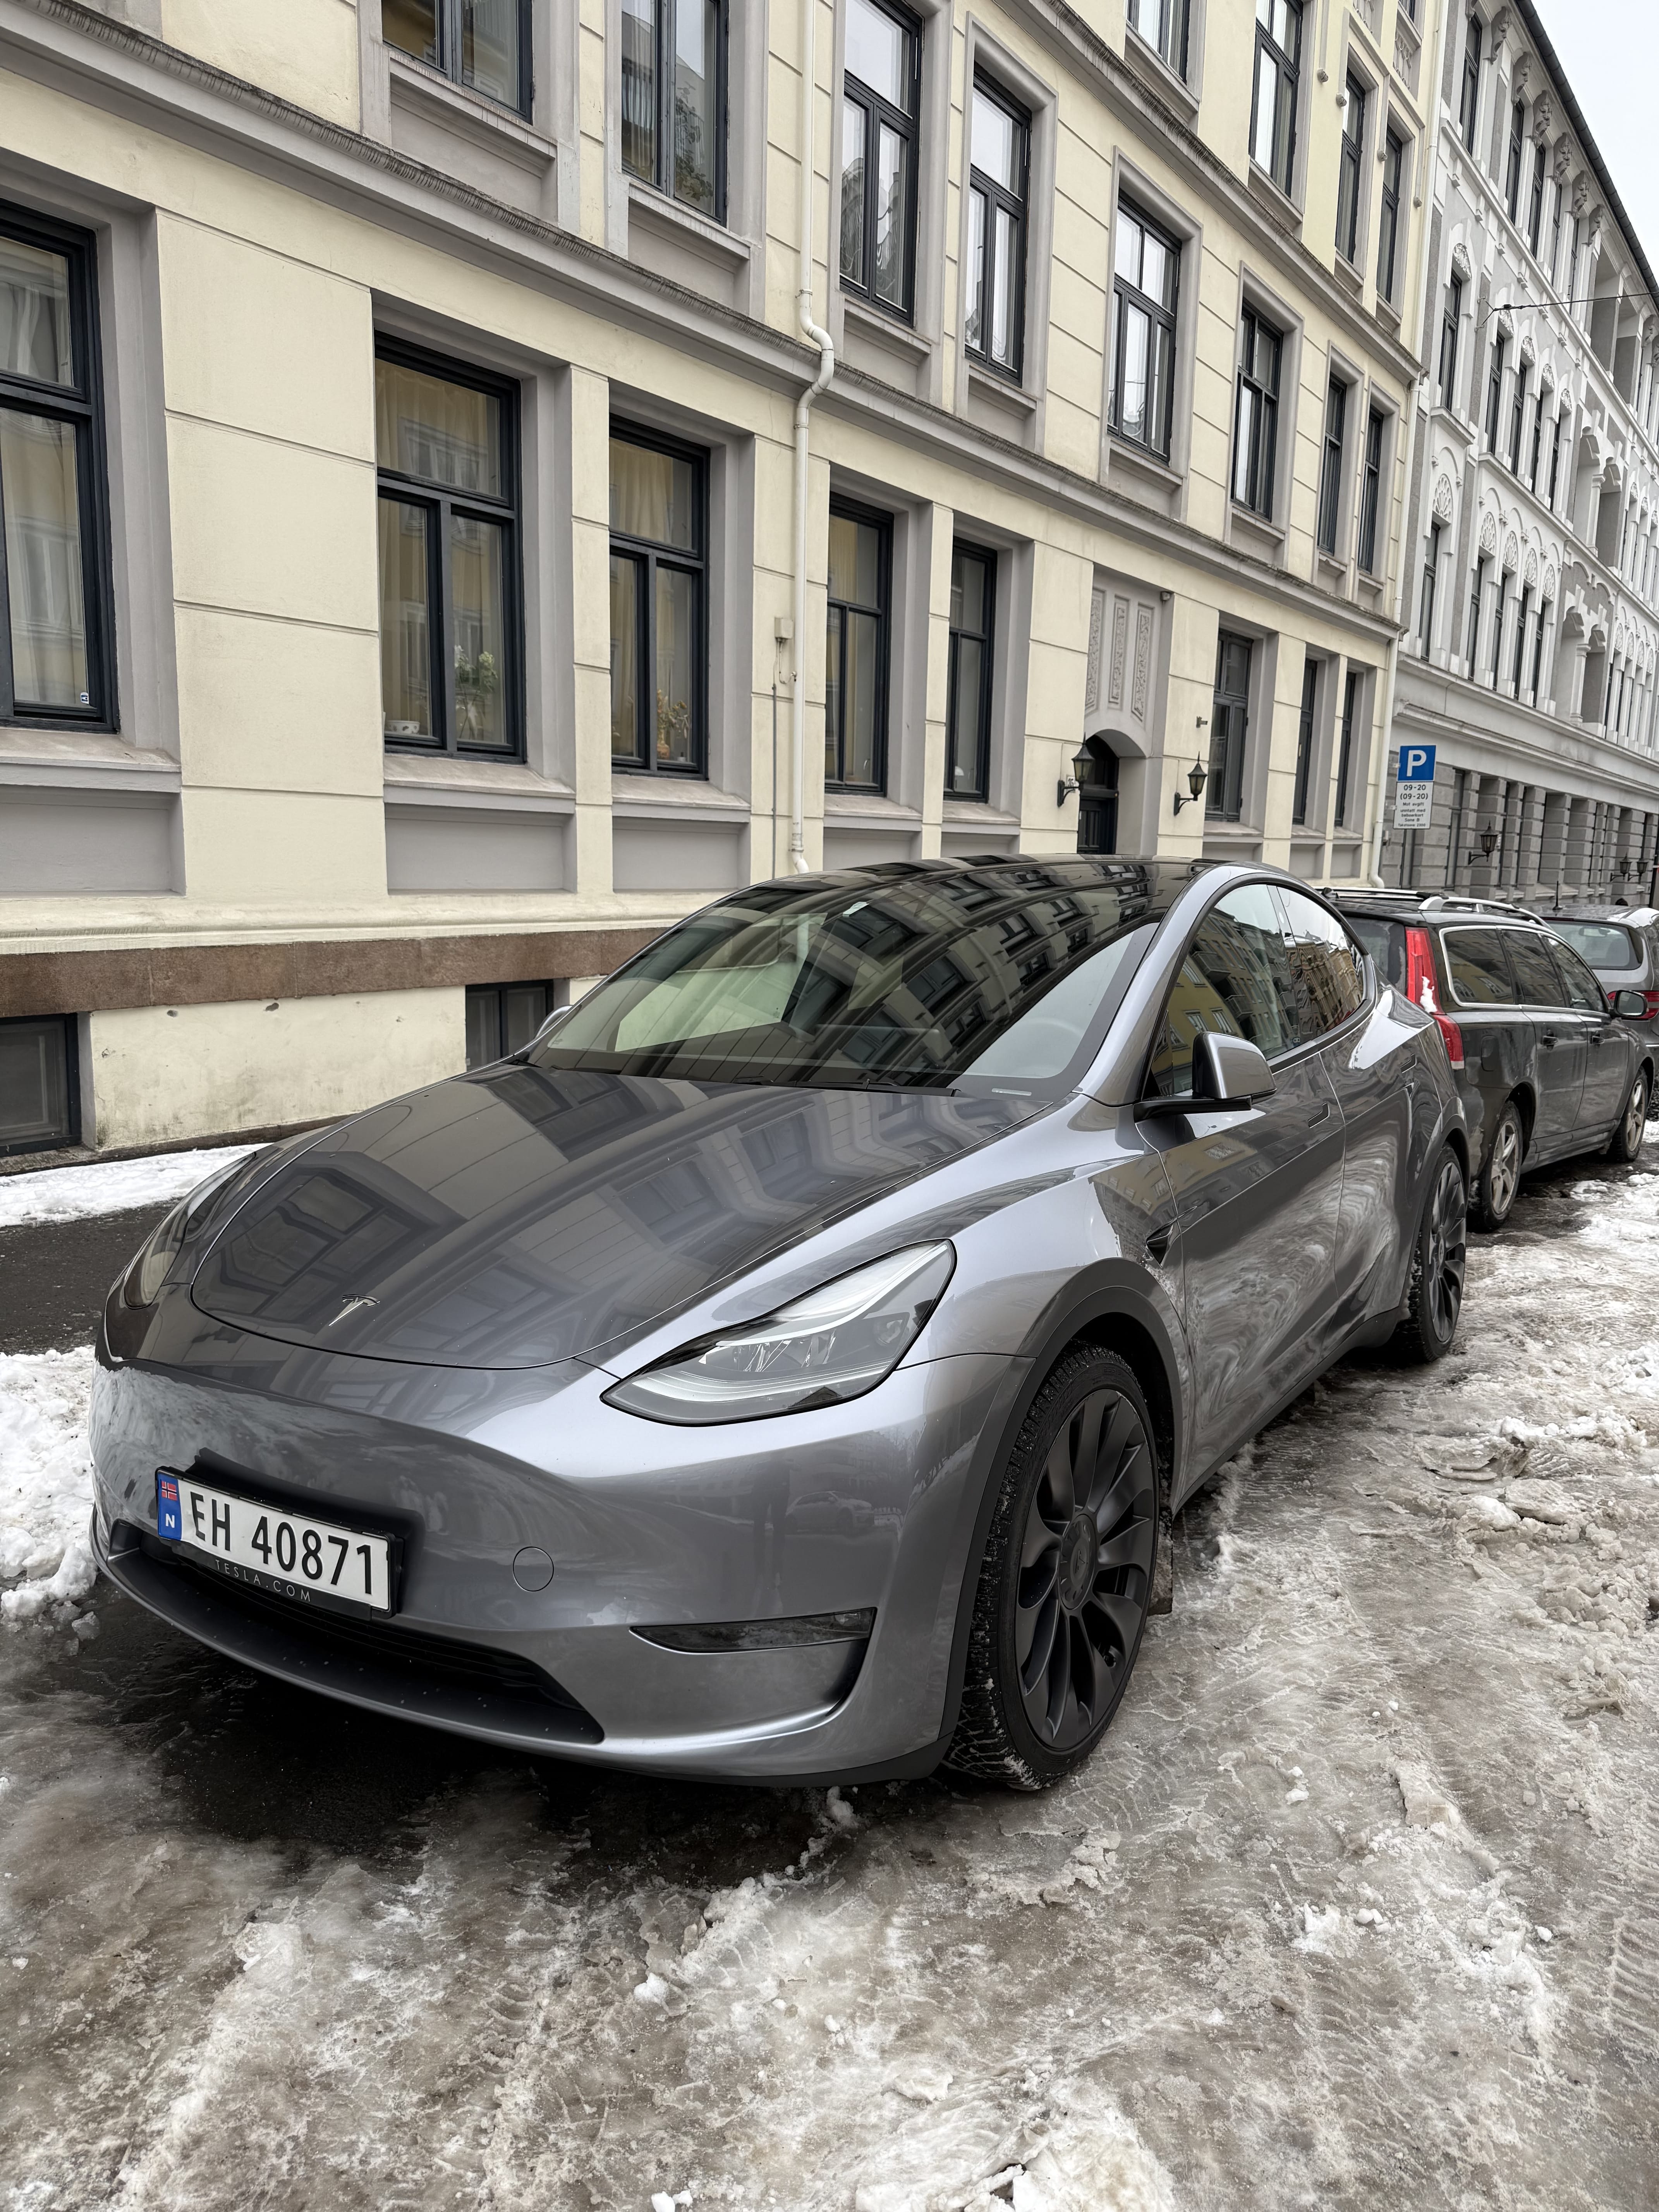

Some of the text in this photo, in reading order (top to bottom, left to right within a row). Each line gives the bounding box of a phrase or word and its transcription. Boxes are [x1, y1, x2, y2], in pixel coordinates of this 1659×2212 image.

[1407, 750, 1427, 776] P
[165, 1513, 175, 1528] N
[190, 1491, 372, 1595] EH 40871
[215, 1559, 311, 1602] TESLA.COM
